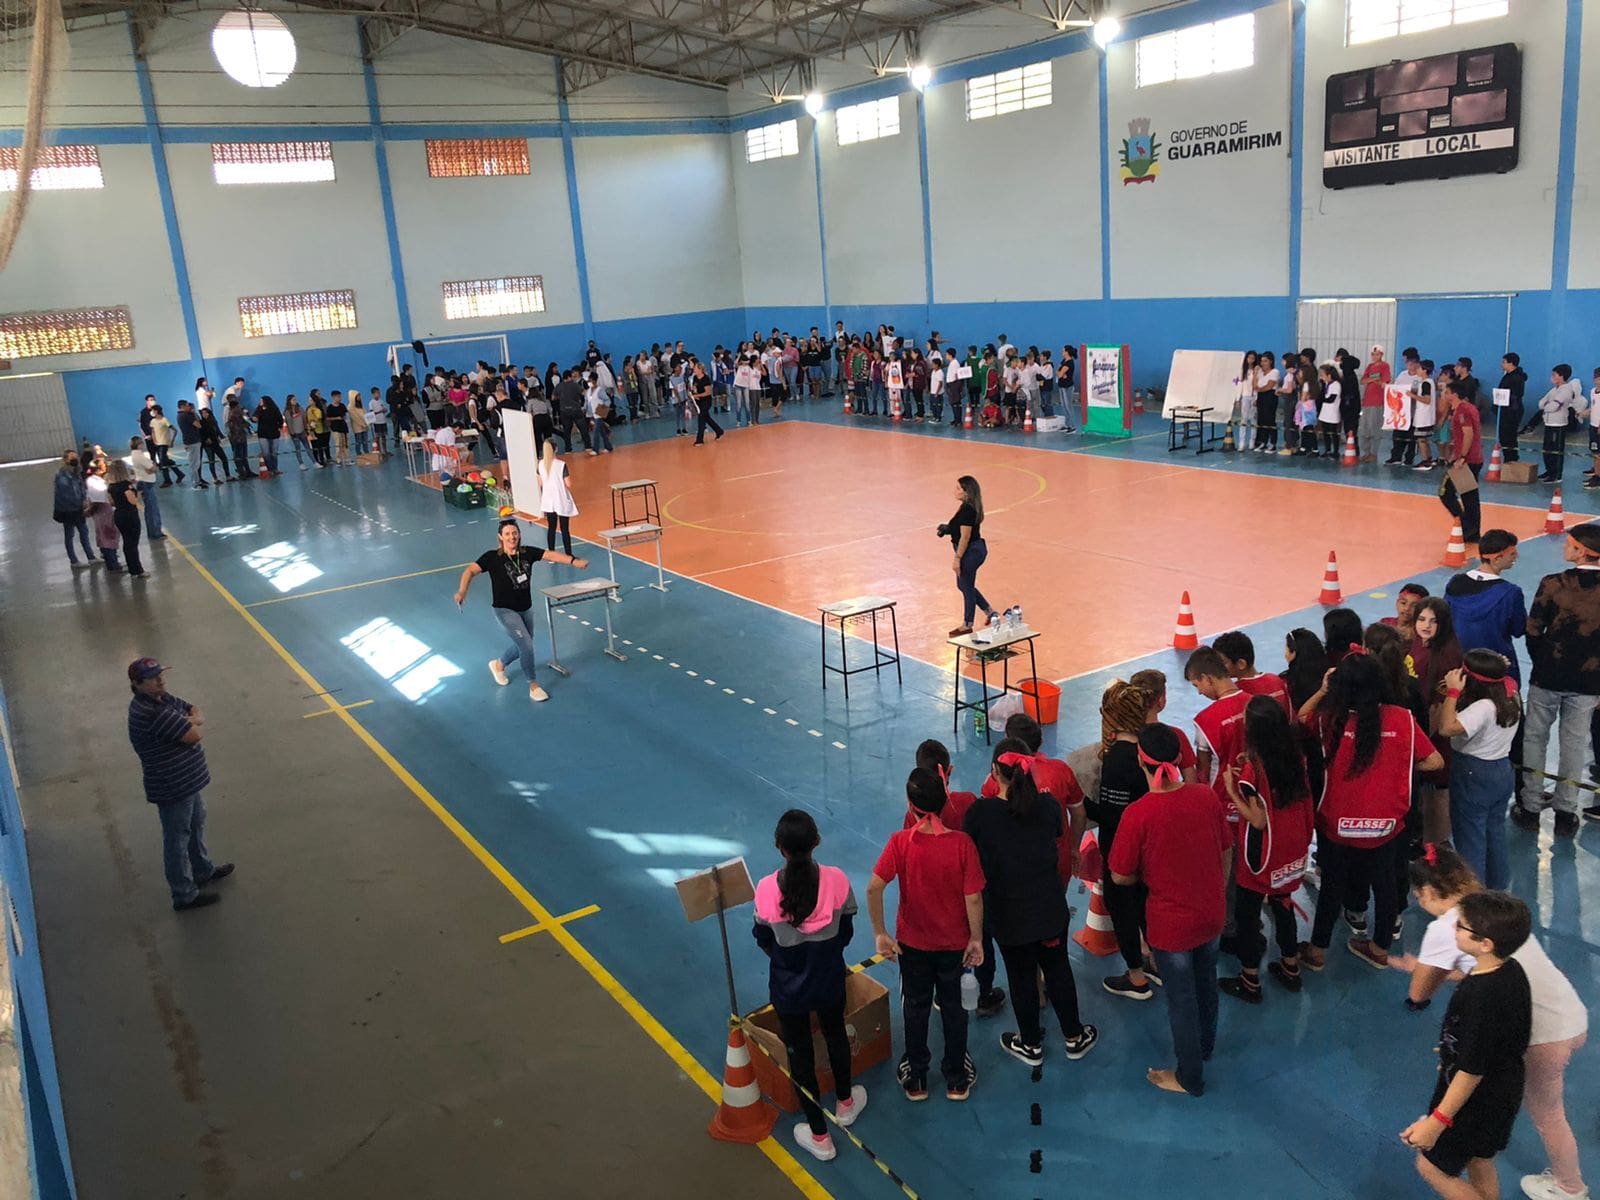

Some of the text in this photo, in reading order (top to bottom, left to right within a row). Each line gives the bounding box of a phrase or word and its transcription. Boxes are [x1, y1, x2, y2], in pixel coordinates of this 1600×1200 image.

[1170, 120, 1248, 144] GOVERNO DE
[1168, 131, 1282, 160] GUARAMIRIM
[1333, 133, 1481, 166] VISITANTE LOCAL
[1341, 820, 1387, 829] CLASSE
